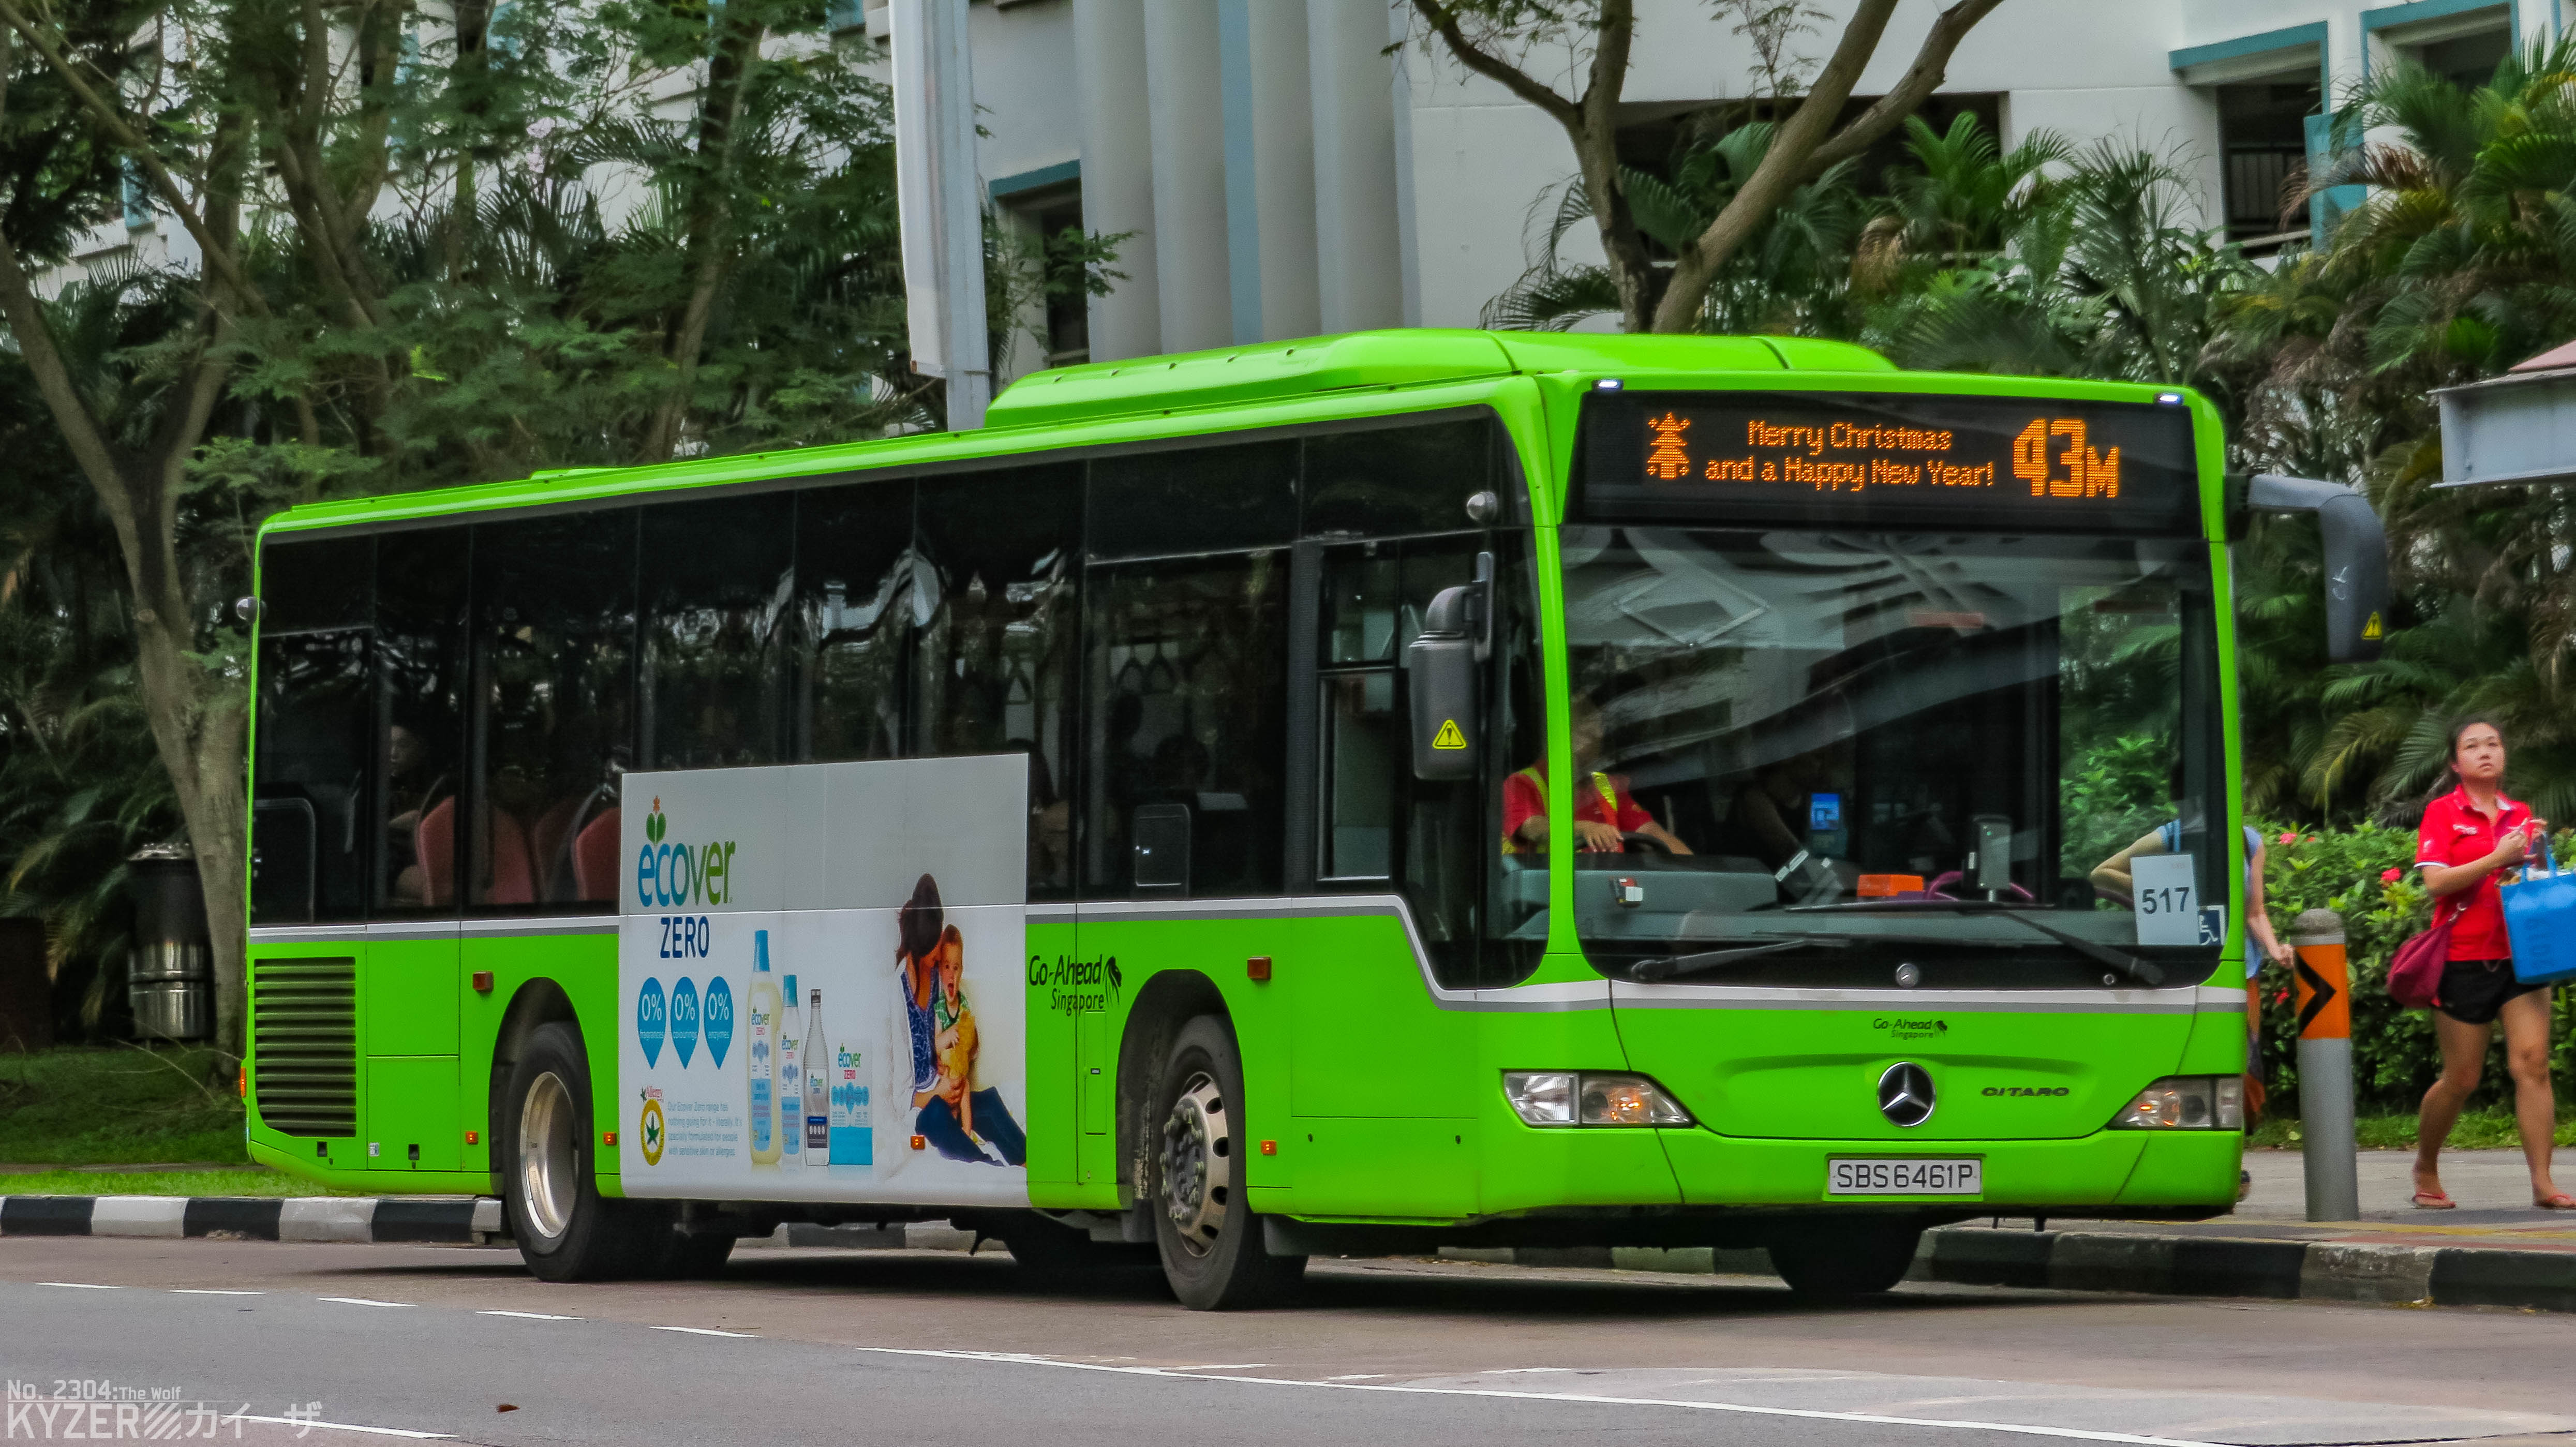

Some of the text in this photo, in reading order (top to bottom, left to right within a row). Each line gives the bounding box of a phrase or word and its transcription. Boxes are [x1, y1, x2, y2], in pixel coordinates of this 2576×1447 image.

[1748, 420, 1952, 456] Merry Christmas
[2013, 418, 2120, 498] 43M
[1705, 455, 1994, 491] and a Happy New Year!
[637, 841, 736, 907] ecover
[2141, 886, 2190, 914] 517
[660, 916, 710, 958] ZERO
[1029, 953, 1103, 986] Go-Ahead
[642, 994, 662, 1021] 0%
[675, 993, 695, 1021] 0%
[708, 993, 729, 1021] 0%
[1051, 988, 1104, 1017] Singapore
[751, 1013, 770, 1025] ecover
[1873, 1018, 1933, 1030] Go-Ahead
[1891, 1030, 1933, 1040] Singapore
[838, 1053, 861, 1068] ecover
[844, 1069, 856, 1080] ZERO
[1837, 1164, 1973, 1188] SBS6461P
